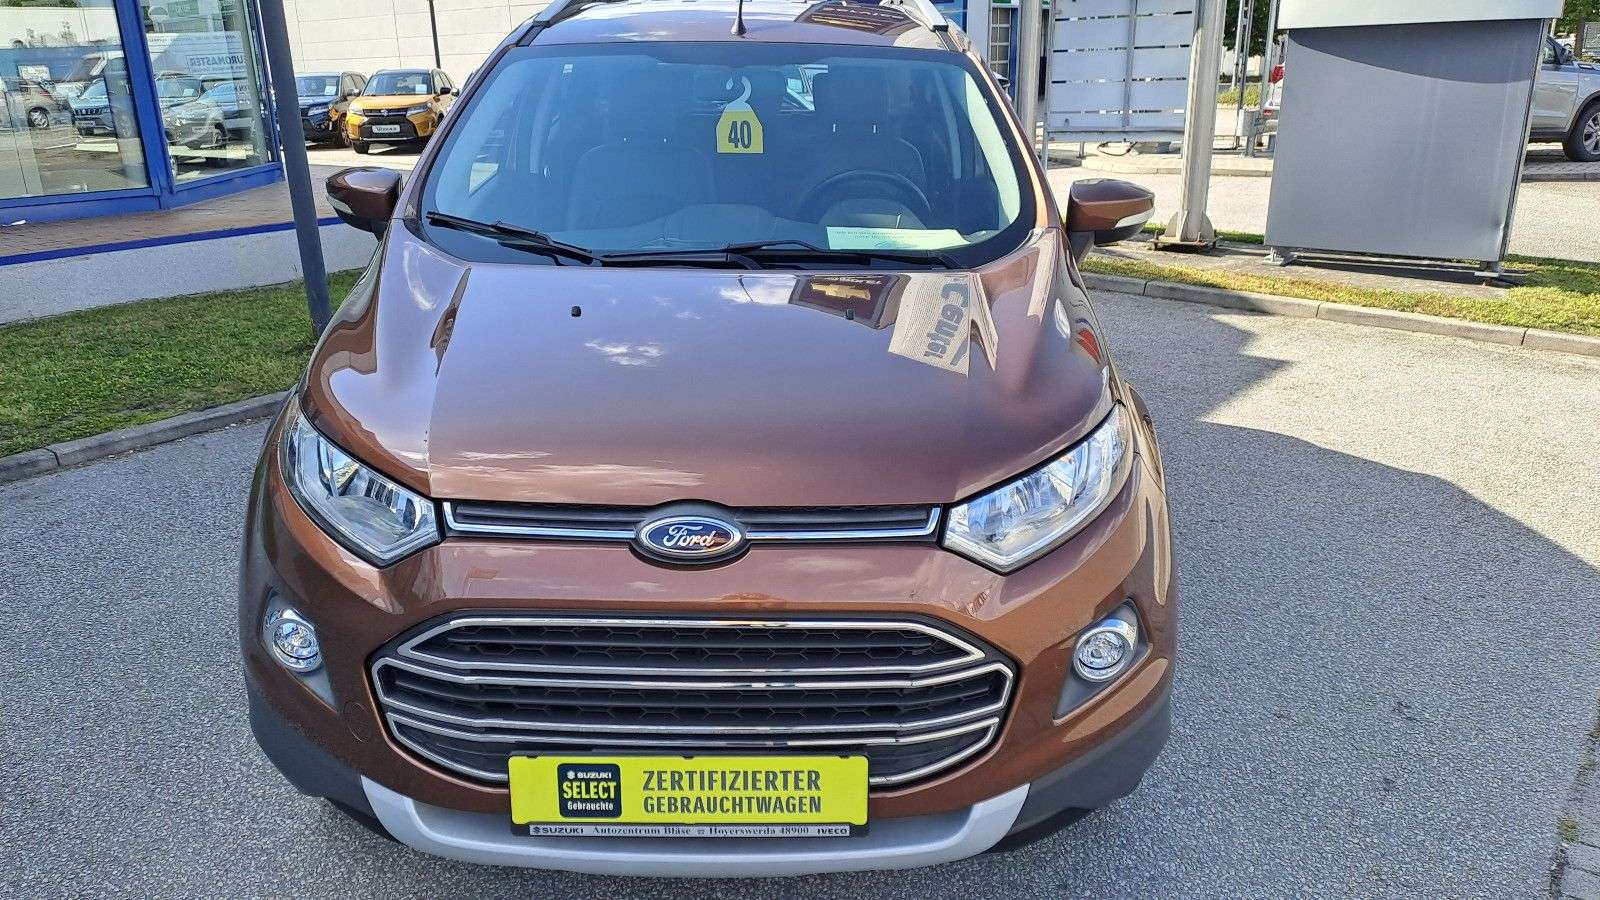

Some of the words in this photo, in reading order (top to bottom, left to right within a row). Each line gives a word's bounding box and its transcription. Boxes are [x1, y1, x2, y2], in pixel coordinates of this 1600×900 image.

[728, 120, 752, 149] 40
[663, 524, 717, 547] Ford
[577, 771, 612, 779] SUZUKI
[642, 770, 822, 792] ZERTIFIZIERTER
[562, 781, 617, 799] SELECT
[567, 801, 614, 811] Gebrauchte
[643, 796, 822, 814] GEBRAUCHTWAGEN
[593, 826, 660, 835] Autozentrum
[709, 826, 776, 837] Hoyerswerda
[817, 827, 848, 835] IVECO
